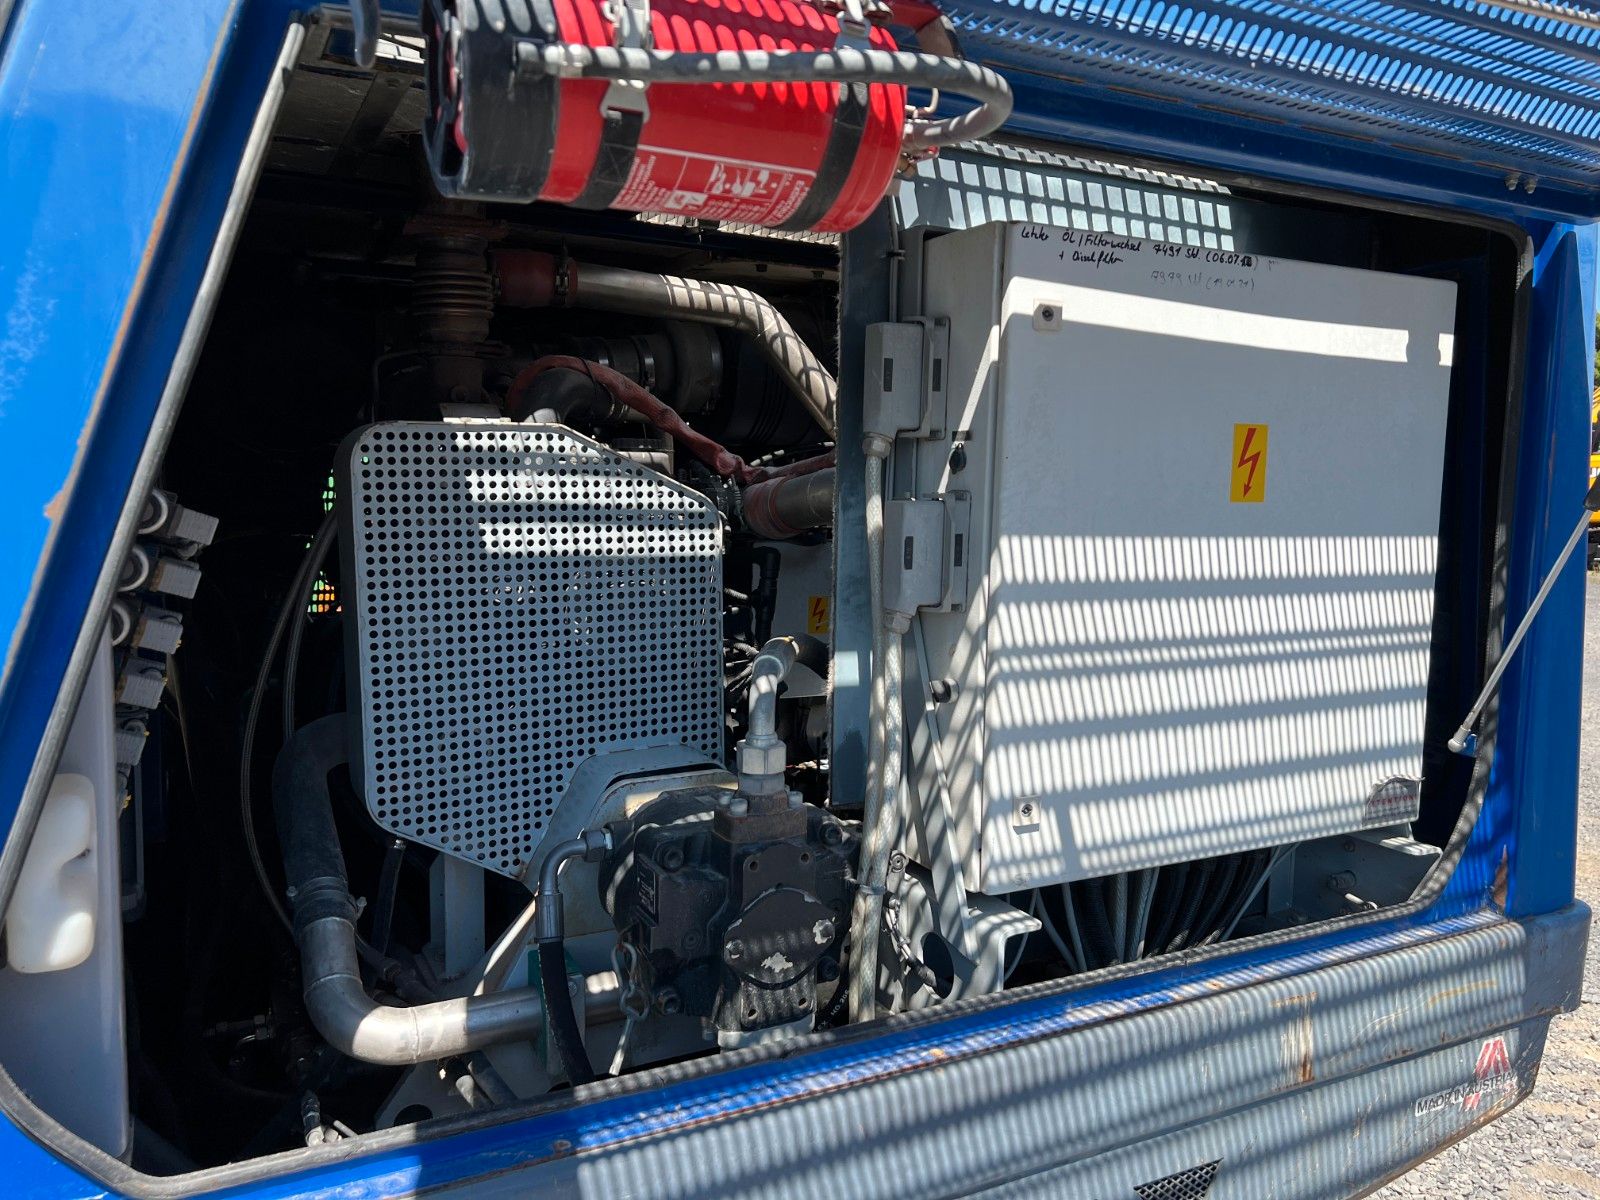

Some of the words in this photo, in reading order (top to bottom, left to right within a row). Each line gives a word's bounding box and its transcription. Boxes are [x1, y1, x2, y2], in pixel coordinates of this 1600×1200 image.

[1152, 244, 1182, 257] 7491
[1417, 1090, 1452, 1114] MADE
[1451, 1087, 1465, 1102] IN
[1464, 1072, 1514, 1097] AUSTRIA
